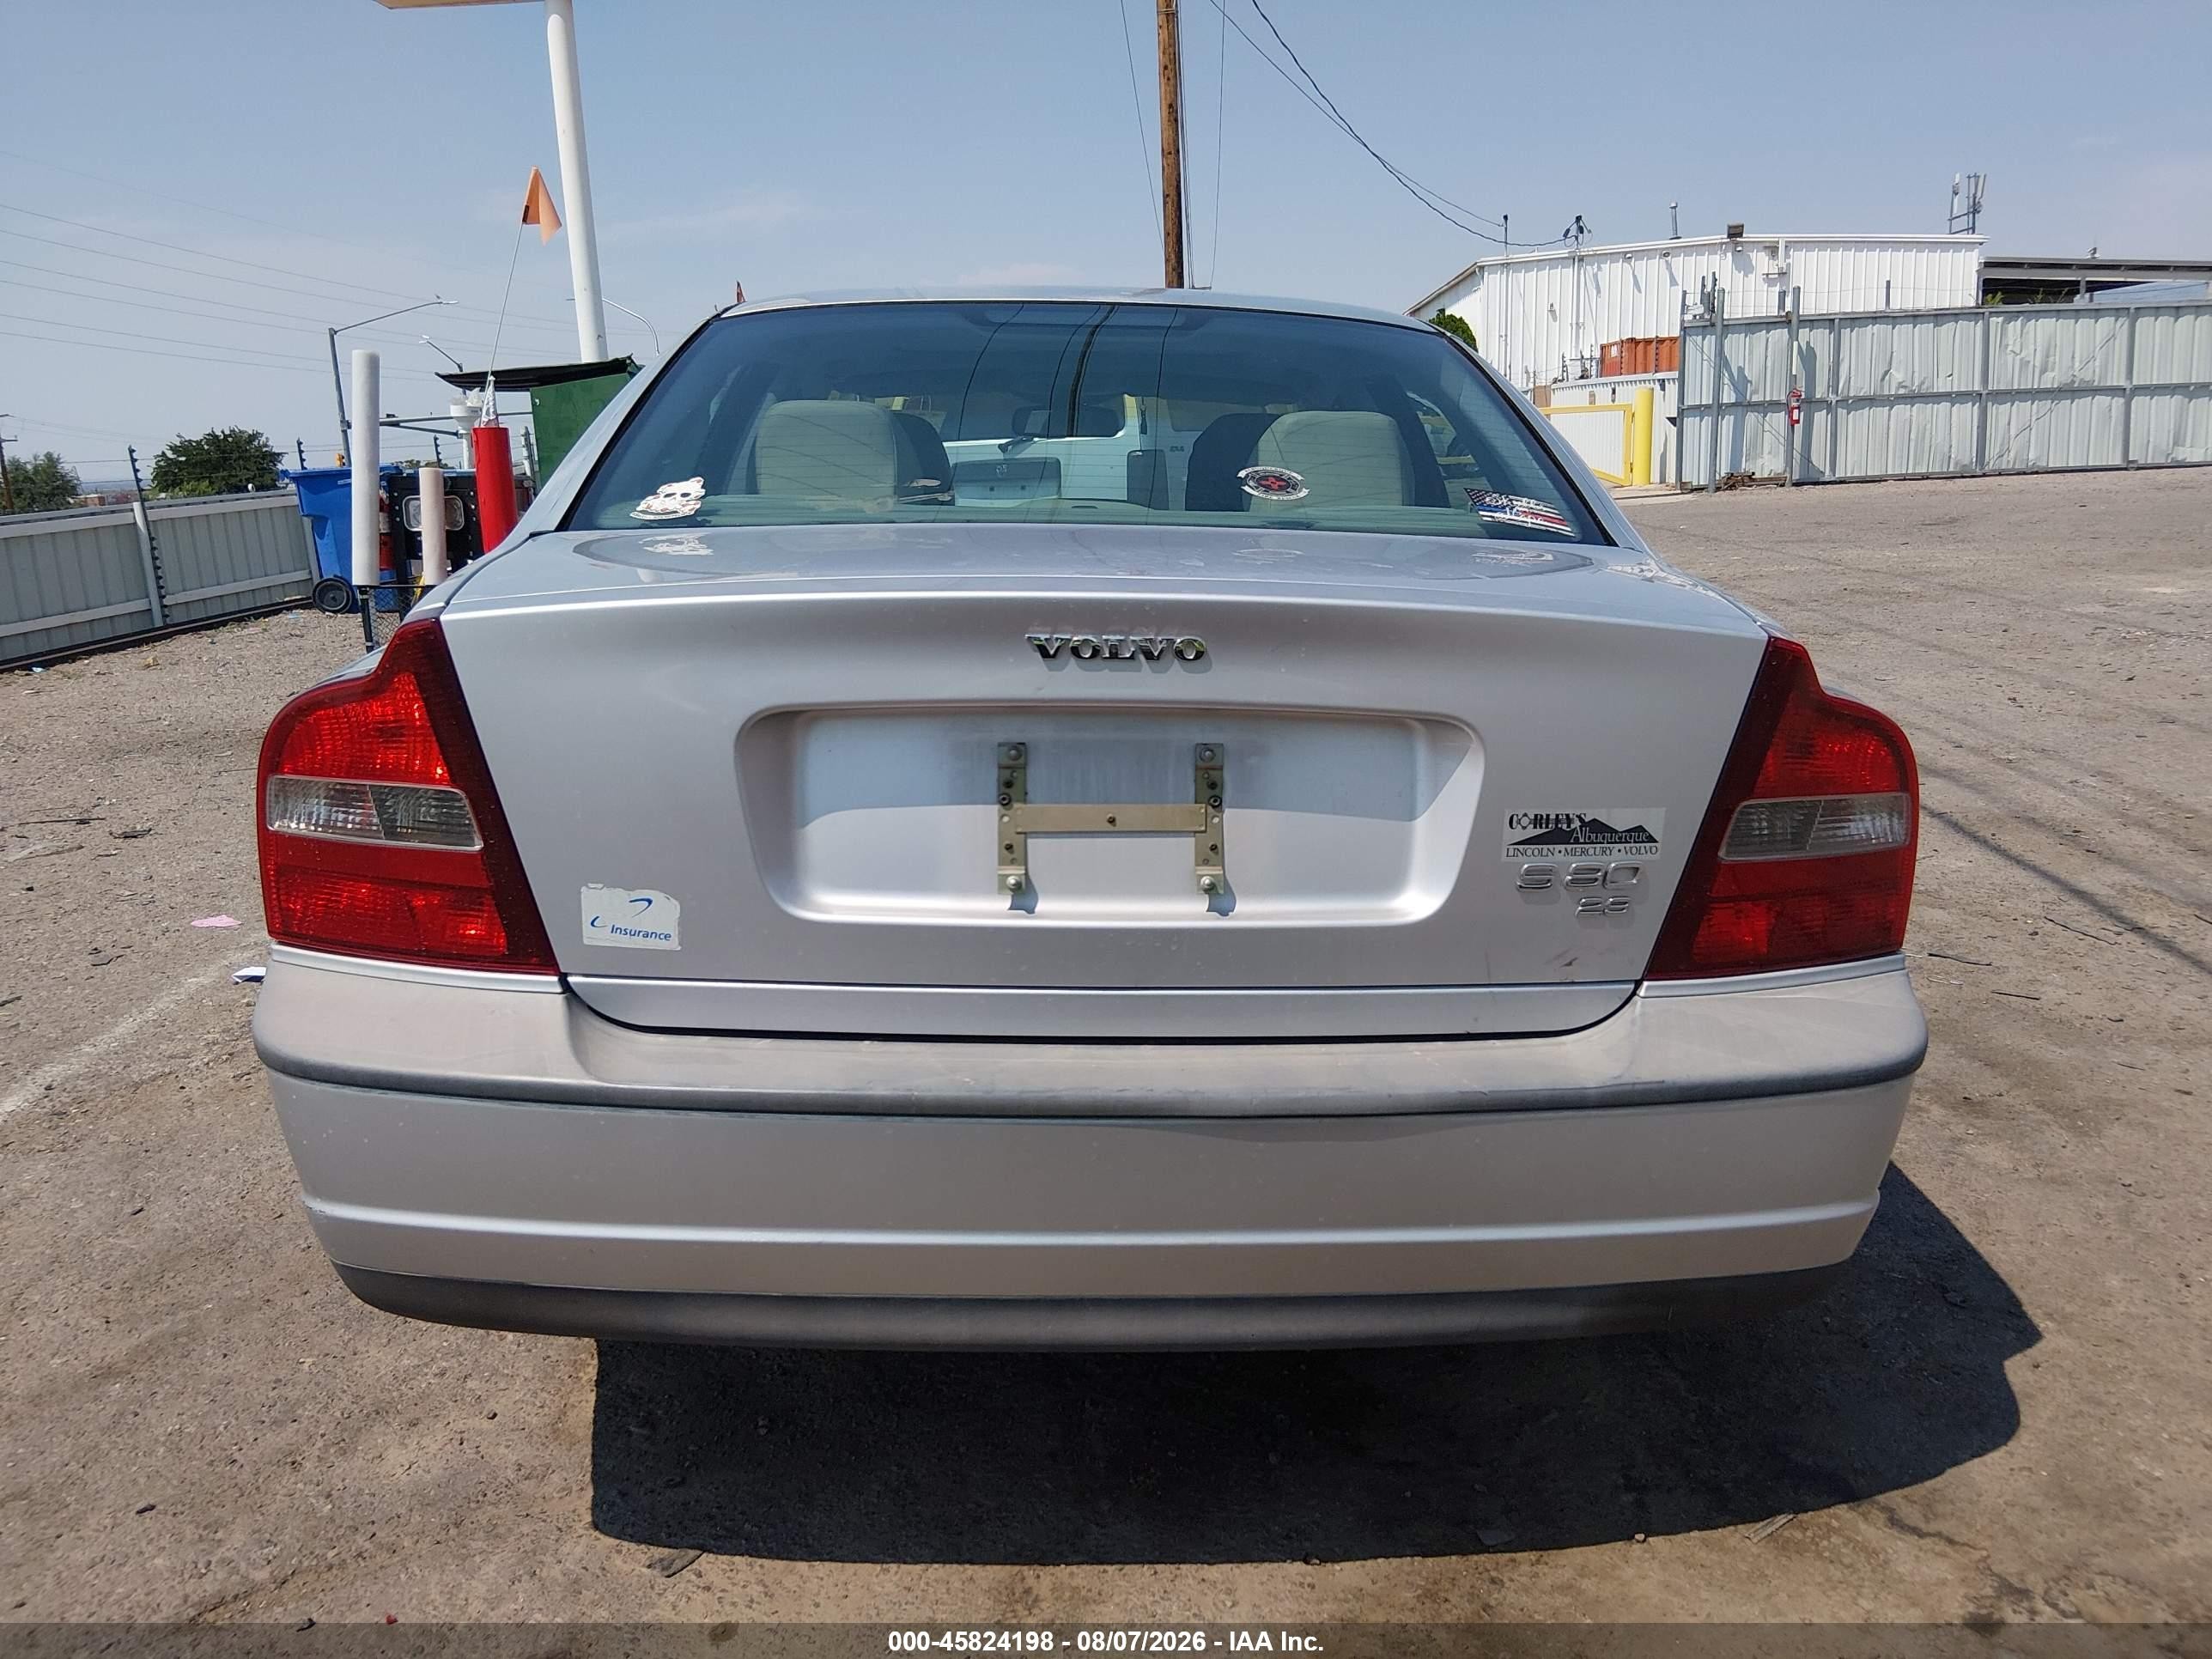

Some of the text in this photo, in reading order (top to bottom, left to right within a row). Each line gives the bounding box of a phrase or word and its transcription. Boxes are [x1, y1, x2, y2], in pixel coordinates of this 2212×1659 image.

[1024, 634, 1208, 661] VOLVO
[1570, 825, 1650, 844] Albuquerque
[1505, 845, 1658, 858] LINCOLN MERCURY VOLVO
[1516, 860, 1643, 892] S80
[611, 924, 672, 941] Insurance
